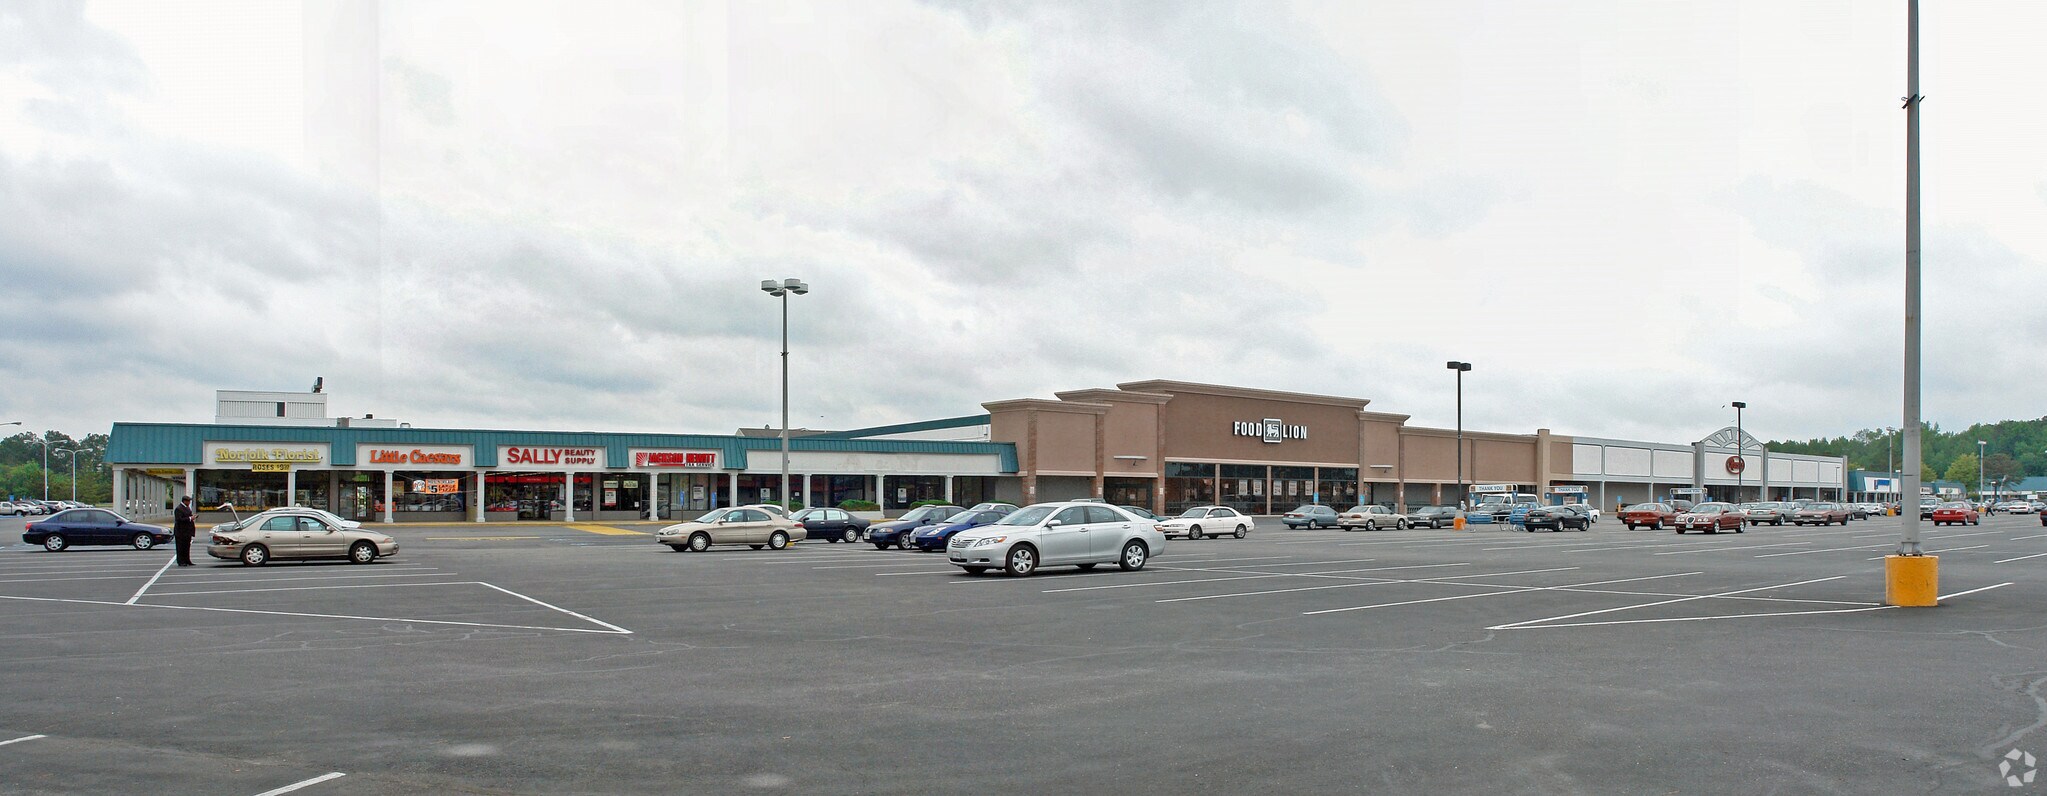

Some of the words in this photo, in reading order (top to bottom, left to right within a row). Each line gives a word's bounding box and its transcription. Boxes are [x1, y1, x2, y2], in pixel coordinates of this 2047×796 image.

[1233, 421, 1263, 437] FOOD
[1282, 424, 1307, 440] LION
[215, 448, 269, 462] Norfolk
[271, 448, 320, 462] Florist
[370, 449, 408, 463] Little
[409, 449, 461, 465] Caesars
[507, 447, 563, 464] SALLY
[649, 452, 684, 463] JACKSON
[686, 453, 716, 463] HEWITT
[252, 463, 275, 471] ROSES
